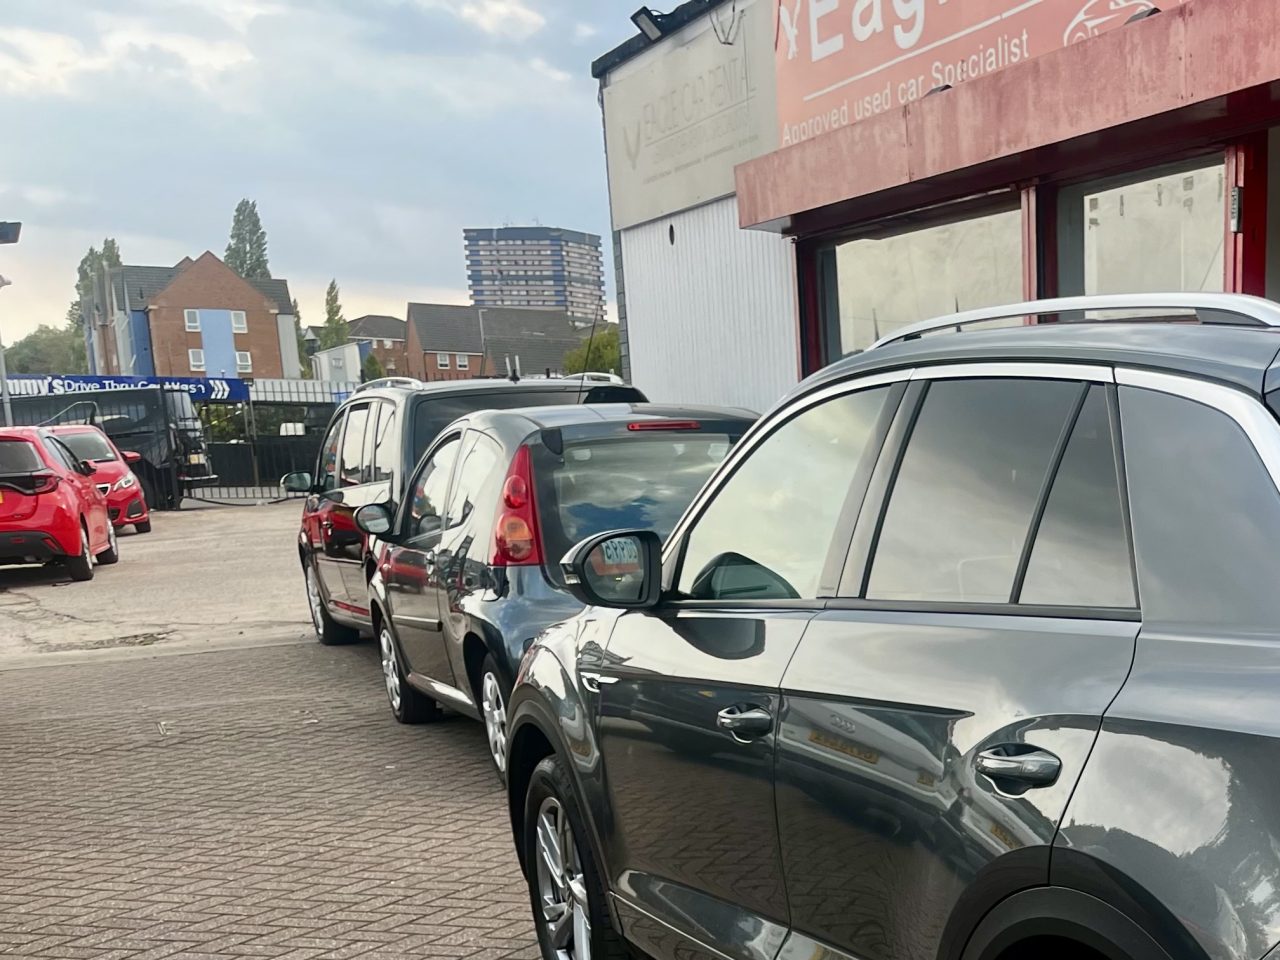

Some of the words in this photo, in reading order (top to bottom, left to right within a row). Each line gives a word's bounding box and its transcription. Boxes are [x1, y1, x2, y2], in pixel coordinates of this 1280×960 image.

[809, 0, 948, 62] Eag
[782, 104, 849, 145] Approved
[854, 90, 891, 117] used
[897, 76, 924, 104] car
[931, 29, 1030, 89] Specialist
[0, 376, 65, 396] mmy's
[64, 379, 100, 392] Drive
